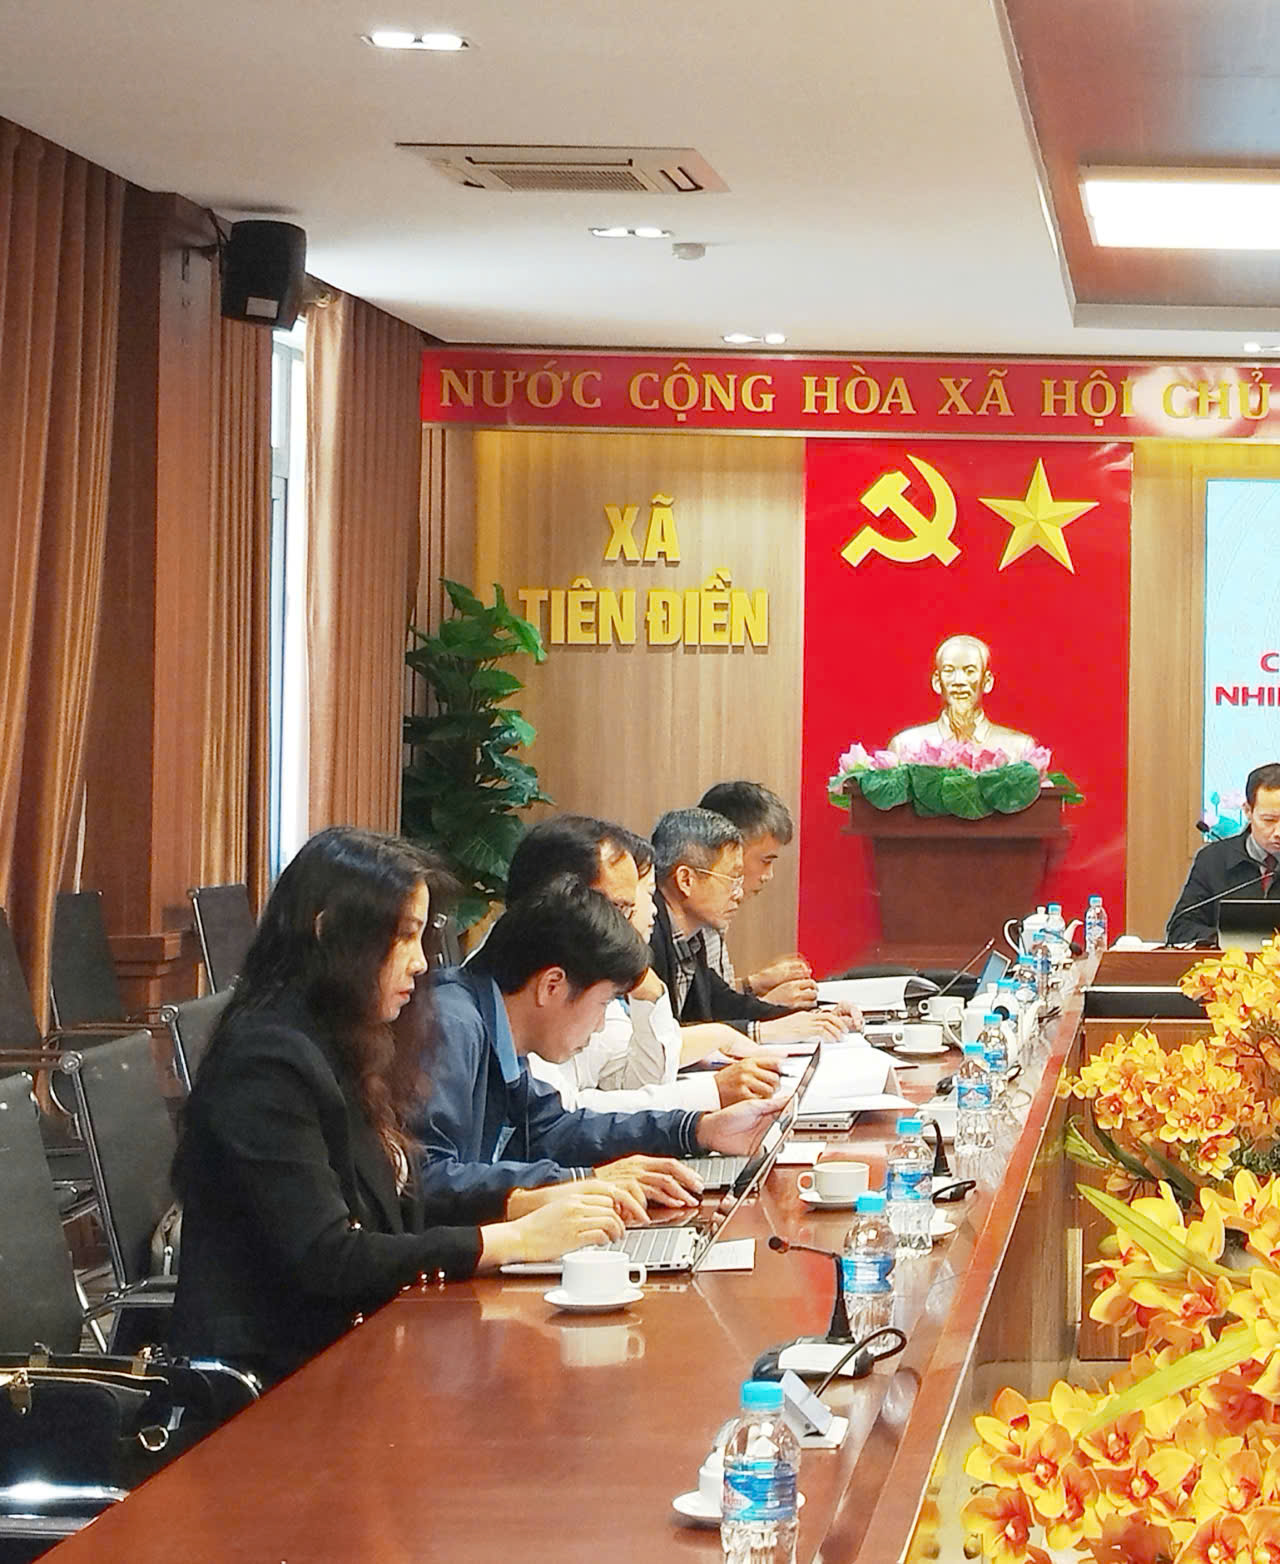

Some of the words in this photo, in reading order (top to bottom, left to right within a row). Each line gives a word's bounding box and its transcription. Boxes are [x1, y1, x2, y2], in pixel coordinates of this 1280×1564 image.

[440, 360, 602, 409] NƯỚC
[629, 362, 774, 424] CỘNG
[802, 364, 917, 416] HÒA
[937, 369, 1016, 418] XÃ
[1041, 366, 1136, 427] HỘI
[1162, 366, 1271, 421] CHỦ
[604, 493, 681, 563] XÃ
[518, 576, 637, 646] TIÊN
[646, 567, 769, 648] ĐIỀN
